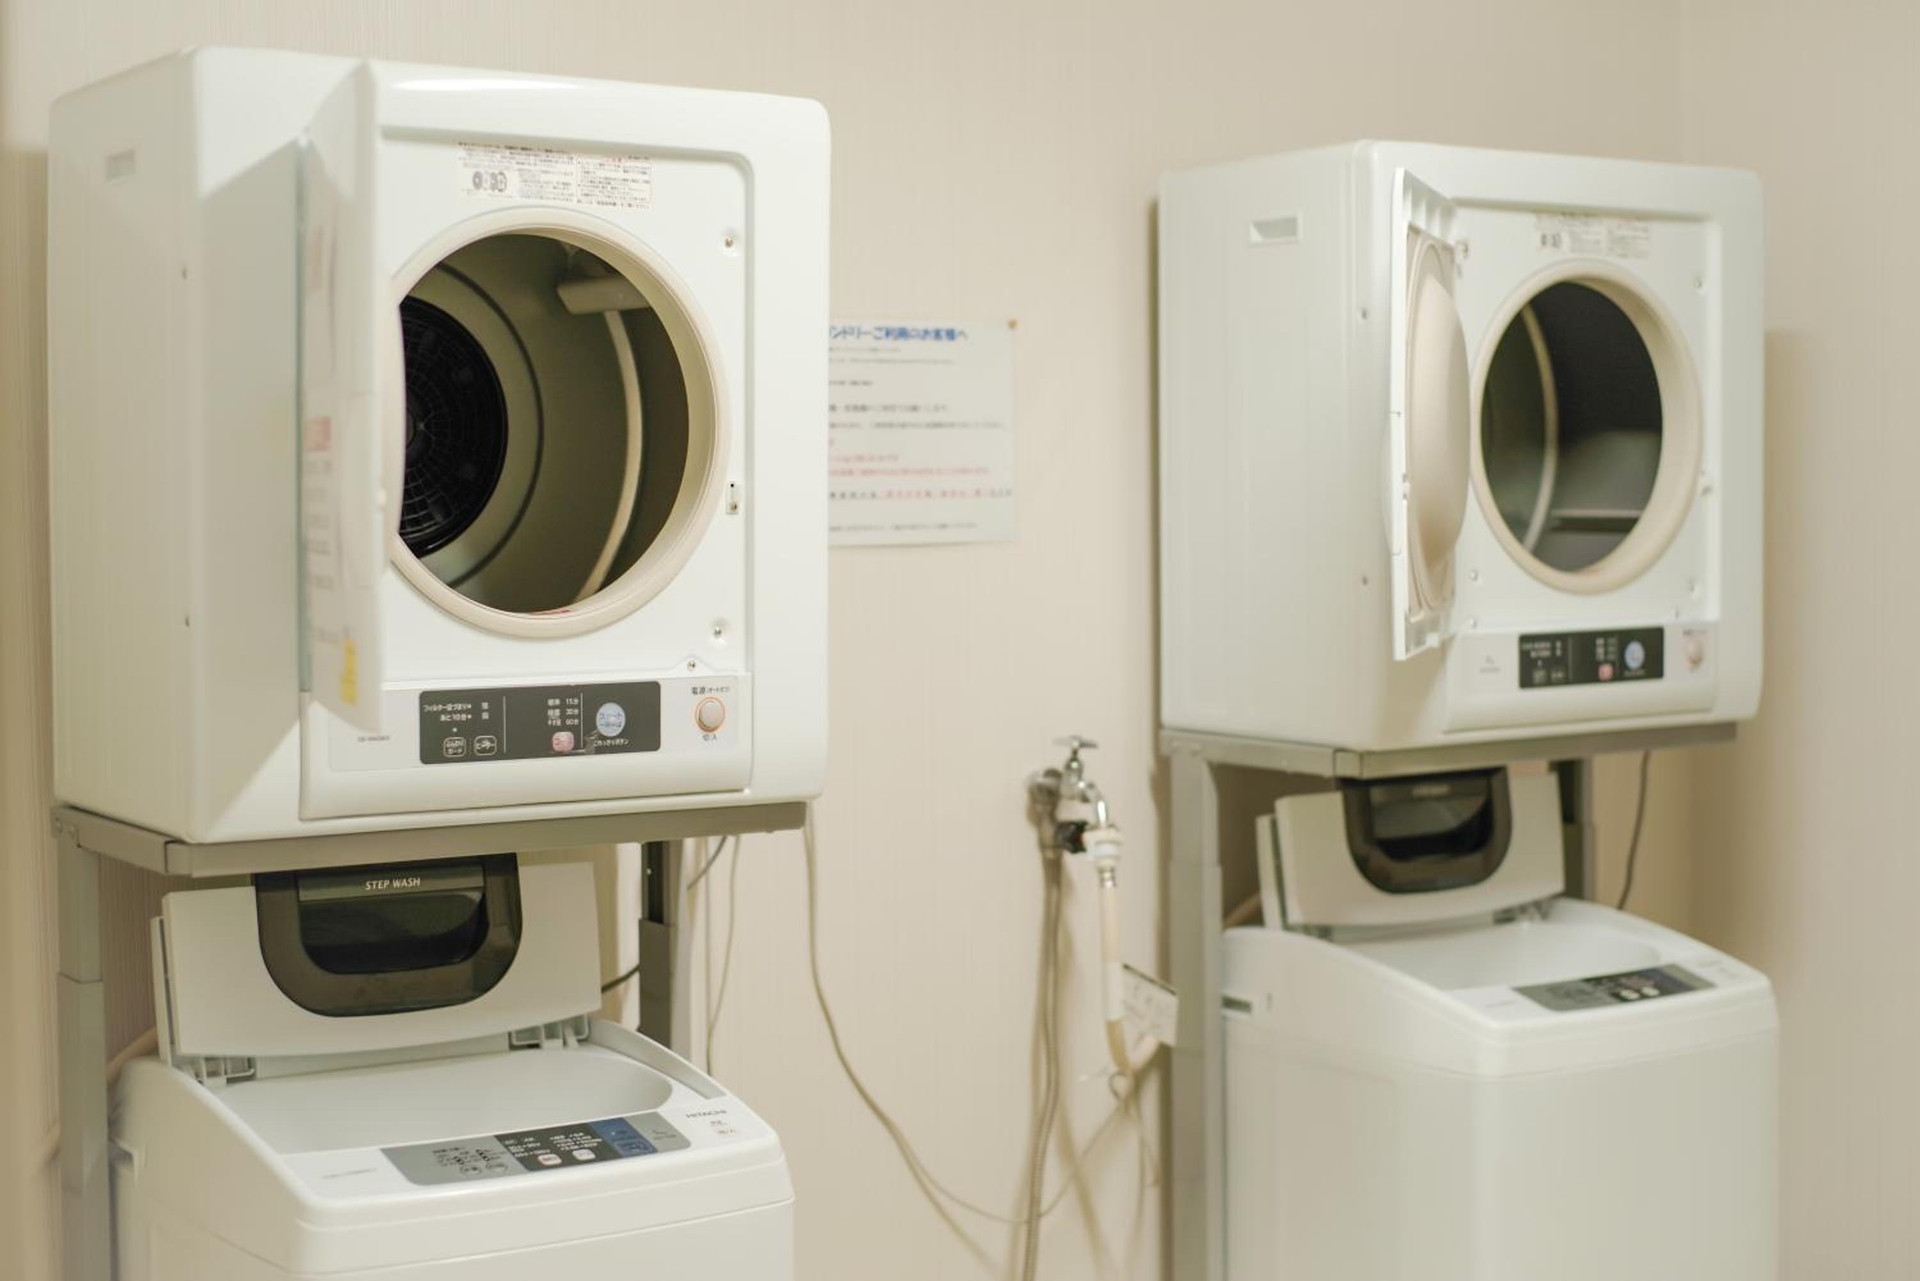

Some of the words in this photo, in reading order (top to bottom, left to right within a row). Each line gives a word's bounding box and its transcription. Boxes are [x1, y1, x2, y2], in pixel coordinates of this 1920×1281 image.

[828, 325, 968, 341] ンドリーご利用のお客様へ
[365, 879, 390, 891] STEP
[392, 877, 420, 889] WASH
